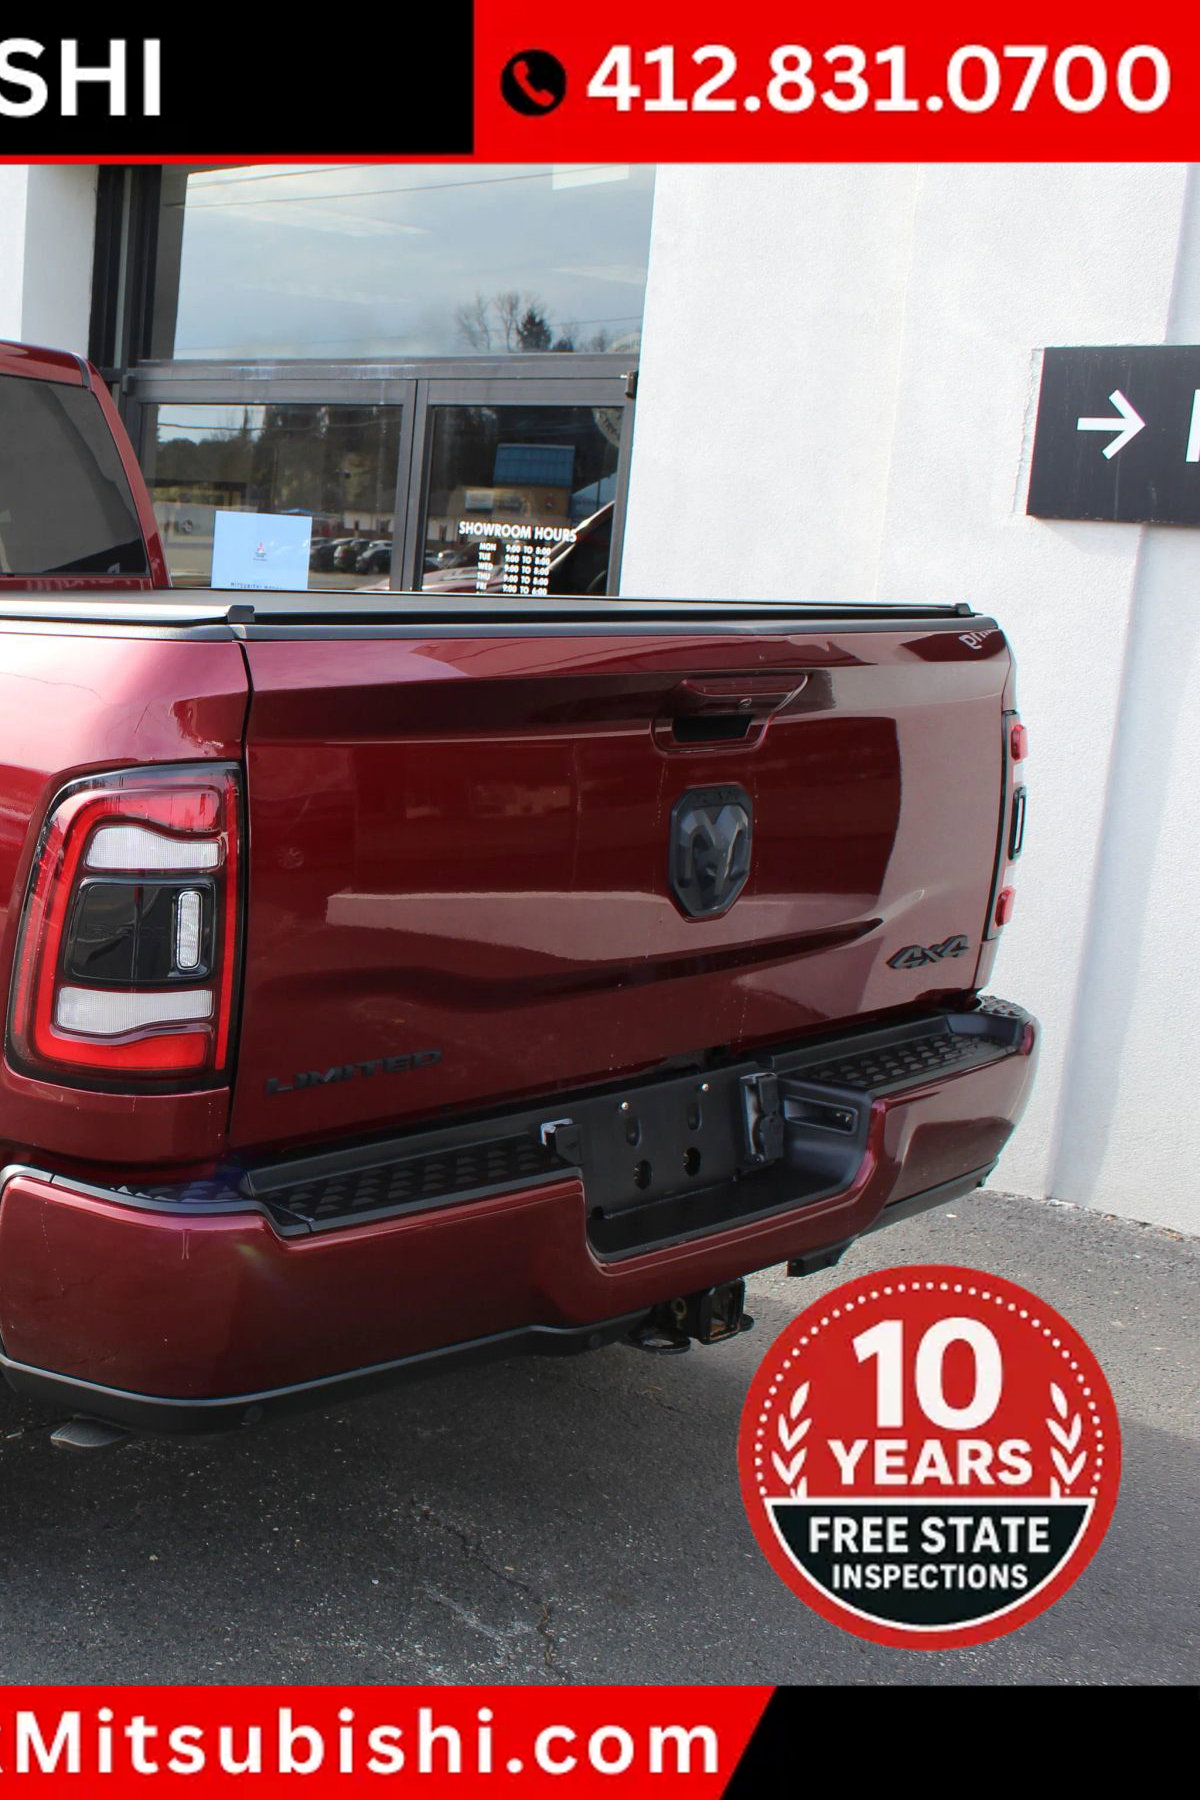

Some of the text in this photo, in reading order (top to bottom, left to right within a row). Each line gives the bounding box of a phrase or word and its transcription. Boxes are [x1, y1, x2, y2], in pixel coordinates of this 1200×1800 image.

[459, 521, 577, 542] SHOWROOM HOURS
[479, 543, 497, 551] MON
[523, 546, 533, 554] TO
[479, 552, 491, 561] TUE
[522, 555, 532, 564] TO
[478, 562, 494, 571] WED
[521, 566, 531, 574] TO
[477, 572, 491, 581] THU
[521, 576, 531, 584] TO
[476, 582, 488, 590] FRI
[520, 585, 530, 594] TO
[266, 1049, 443, 1094] LIMITED
